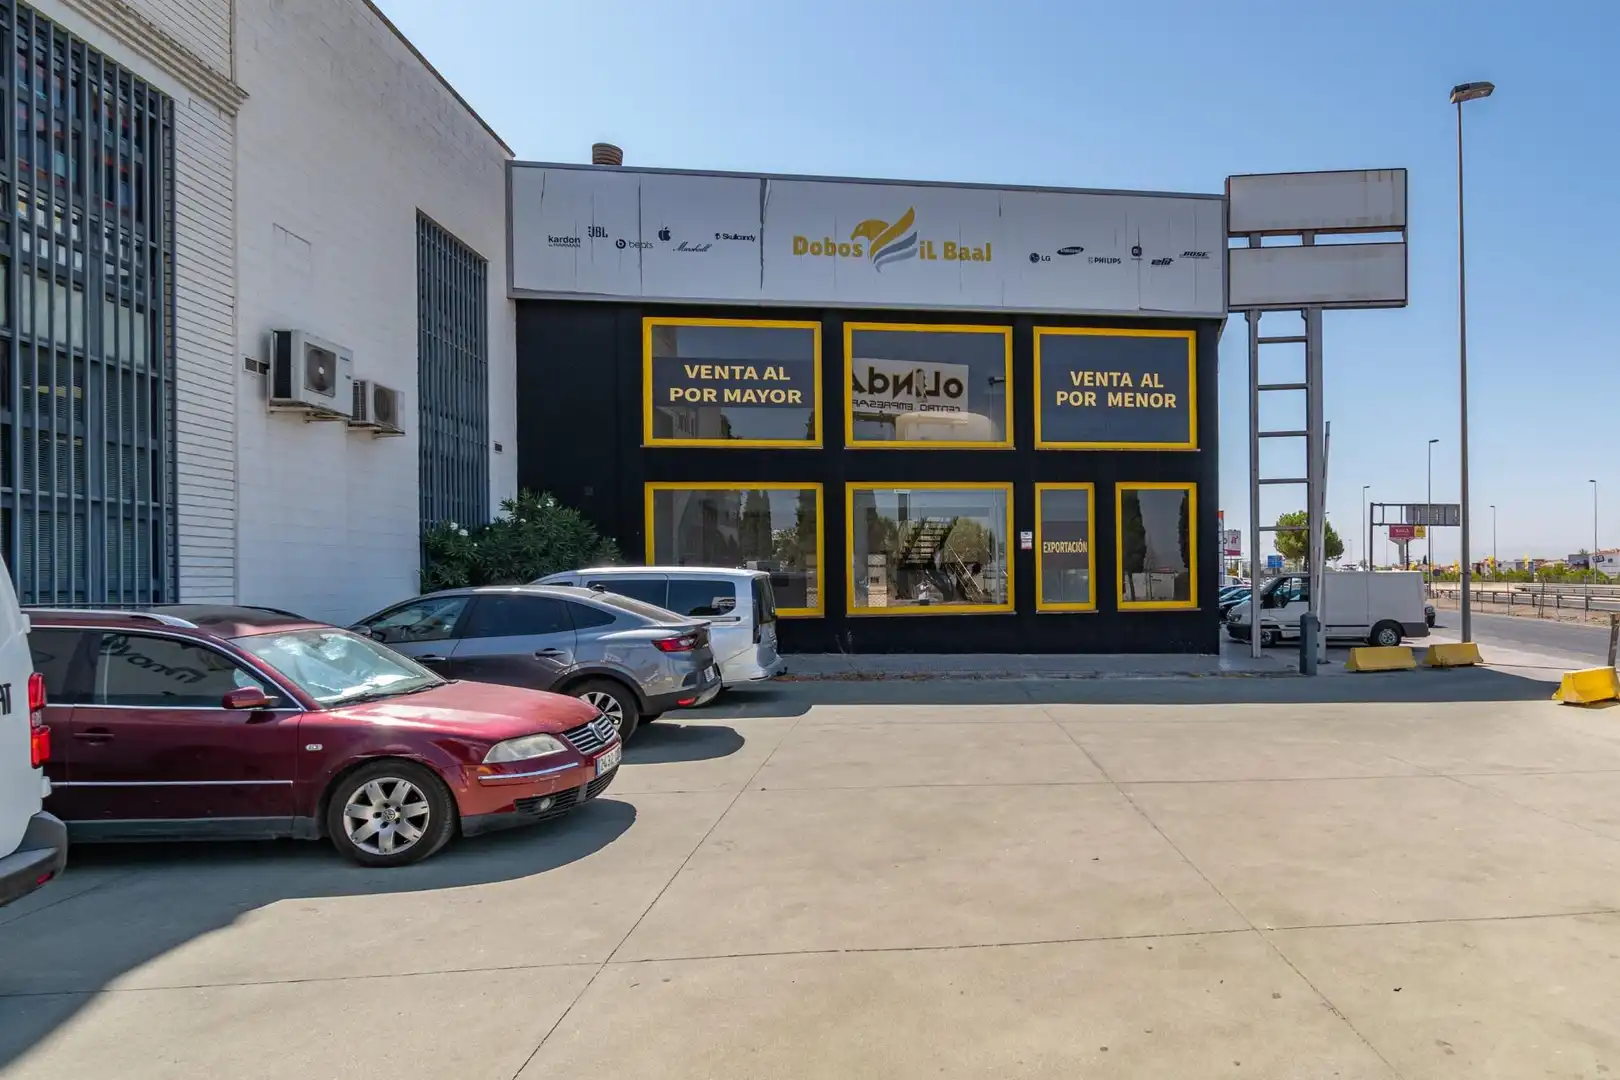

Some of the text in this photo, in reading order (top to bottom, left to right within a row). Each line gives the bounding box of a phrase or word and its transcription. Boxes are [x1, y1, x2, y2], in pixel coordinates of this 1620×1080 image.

[548, 235, 581, 244] kardon
[588, 226, 608, 238] JBL
[628, 240, 654, 249] beats
[793, 235, 863, 258] Dobos
[943, 241, 992, 262] Baal
[1094, 257, 1122, 265] PHILIPS
[684, 364, 791, 381] VENTA AL
[1070, 370, 1164, 388] VENTA AL
[669, 387, 802, 404] POR MAYOR
[1056, 391, 1177, 409] POR MENOR
[1043, 538, 1088, 554] EXPORTACIÓN
